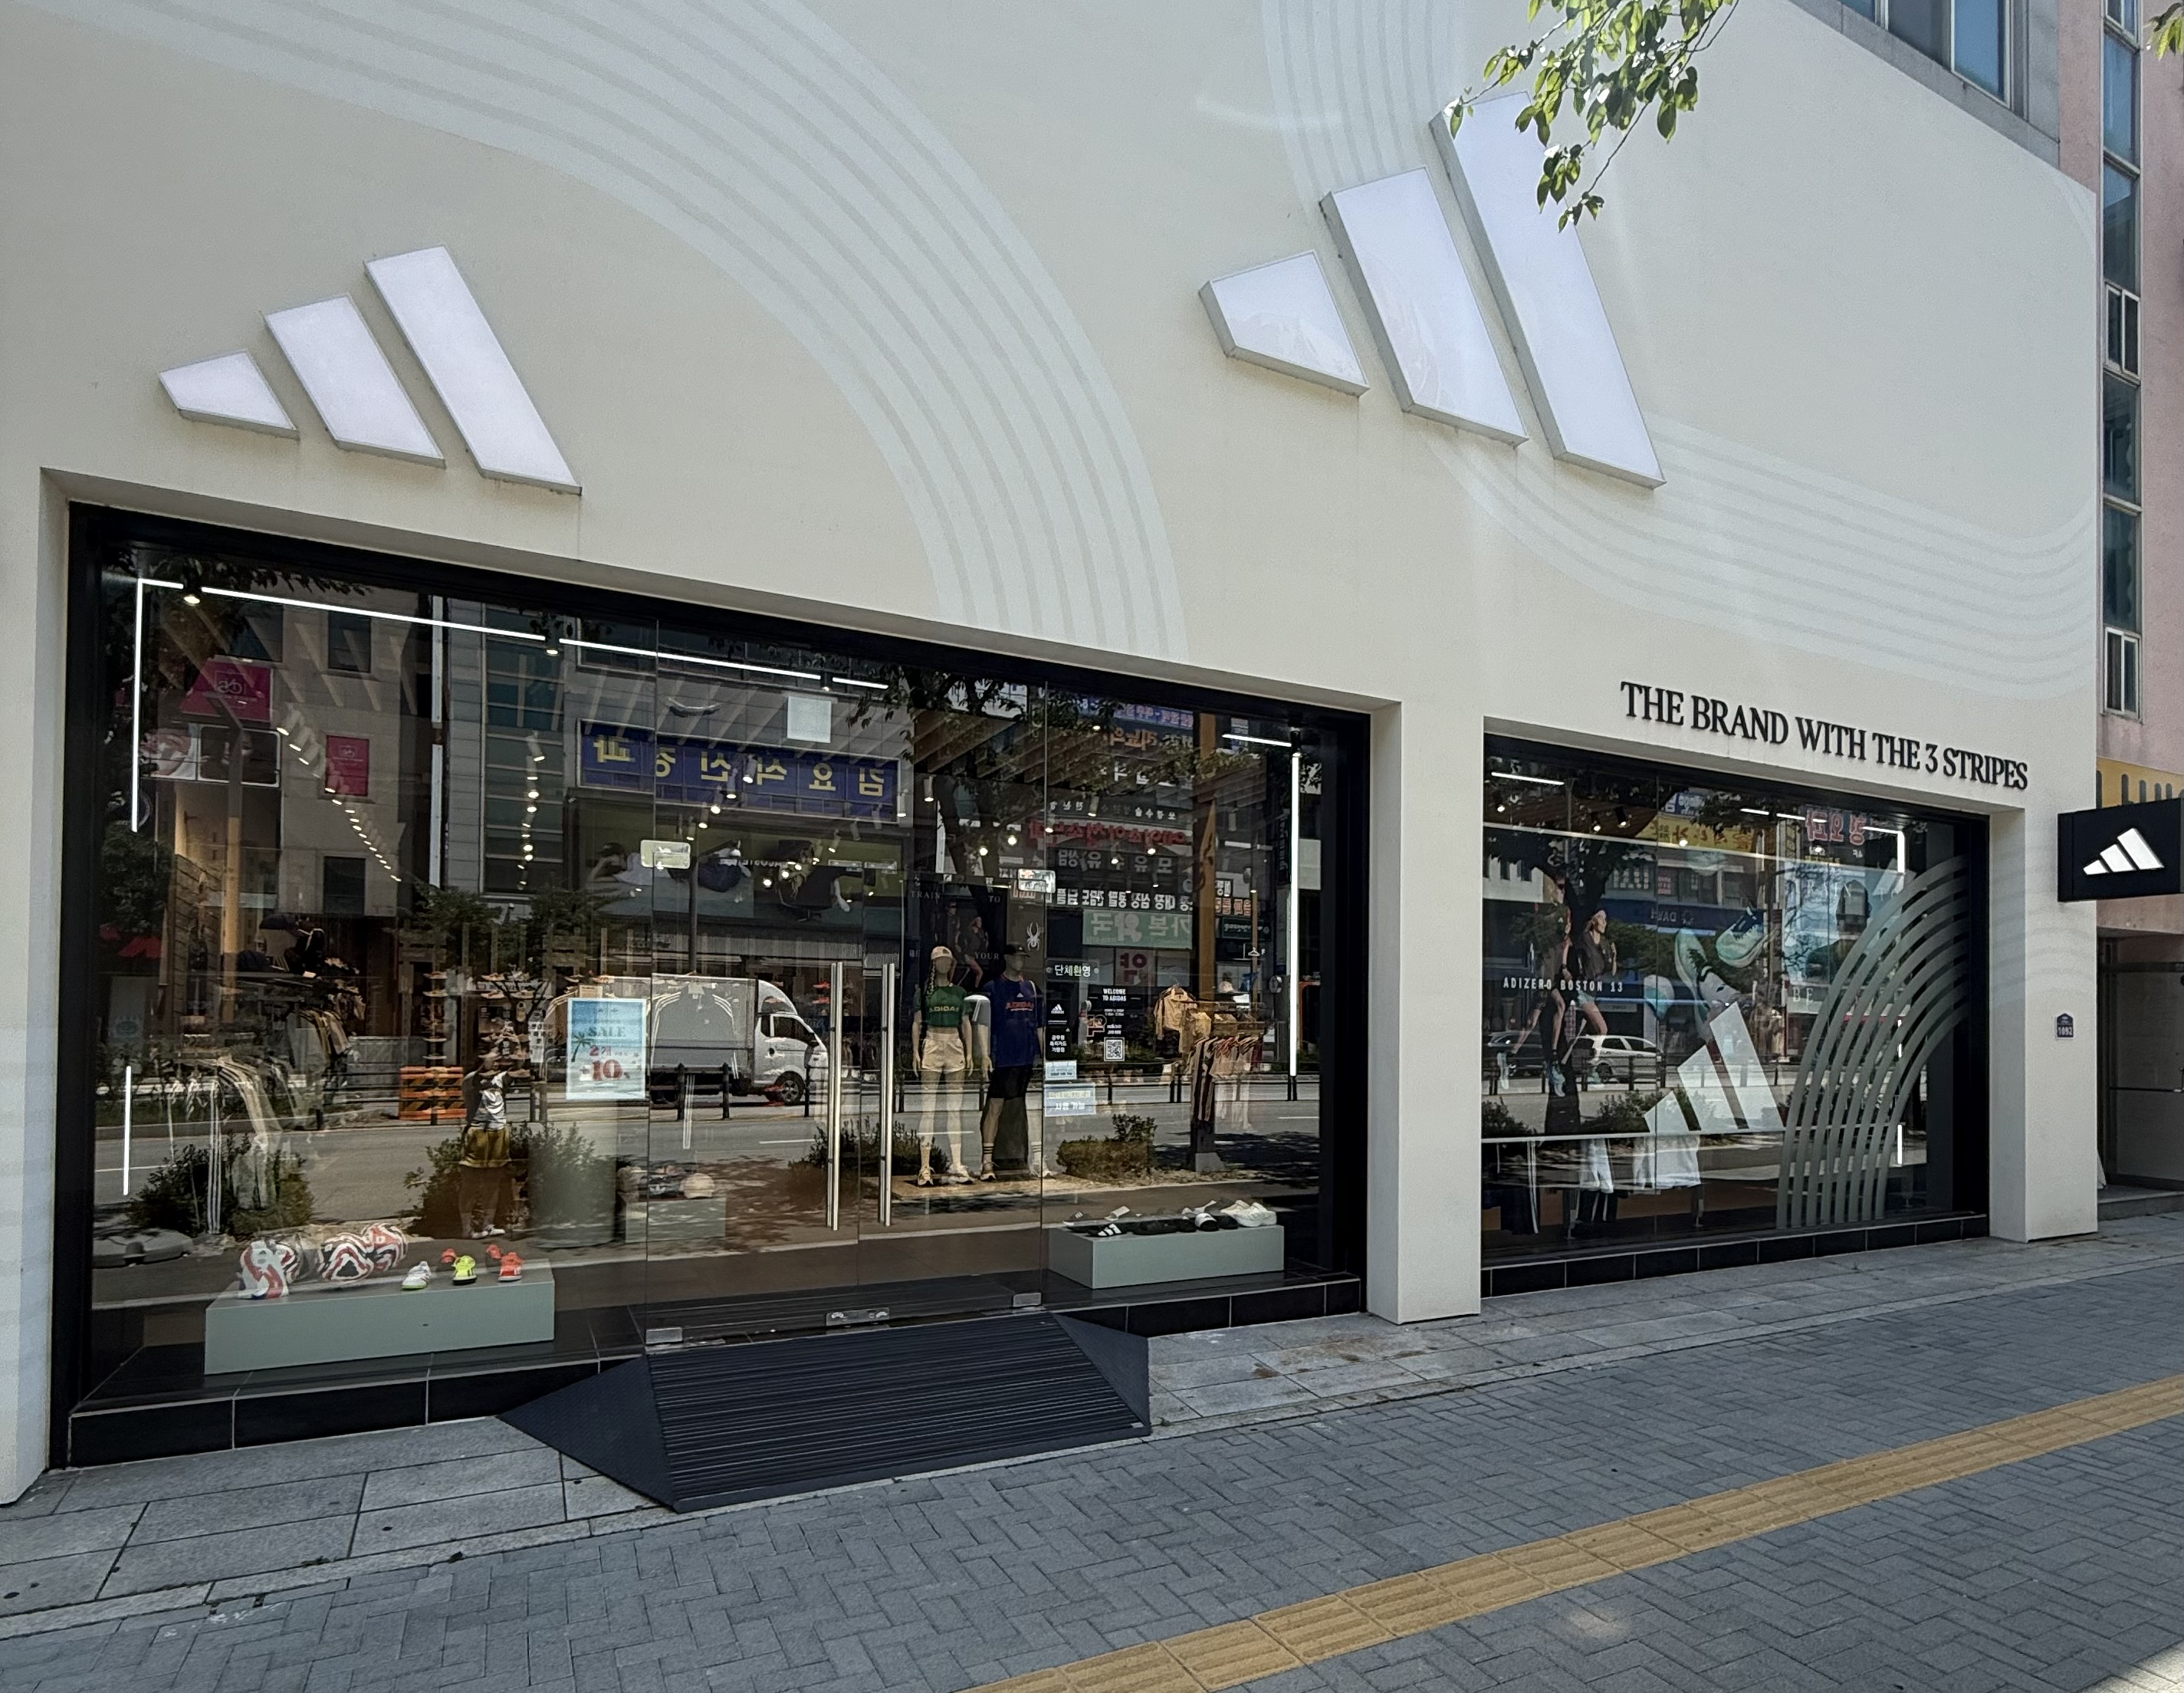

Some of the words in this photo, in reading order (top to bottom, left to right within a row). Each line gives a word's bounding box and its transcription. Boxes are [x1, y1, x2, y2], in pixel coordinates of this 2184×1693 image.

[1621, 681, 1684, 726] THE
[1690, 695, 1788, 745] BRAND
[1795, 715, 1866, 761] WITH
[1872, 731, 1920, 769] THE
[1925, 743, 1938, 773] 3
[1943, 750, 2028, 791] STRIPES
[987, 895, 1001, 903] TO
[974, 951, 1000, 960] YOUR
[1054, 964, 1091, 978] 단체환영
[1503, 976, 1552, 991] ADIZERO
[1560, 979, 1603, 992] BOSTON
[1611, 981, 1624, 993] 13
[588, 1025, 626, 1037] SALE
